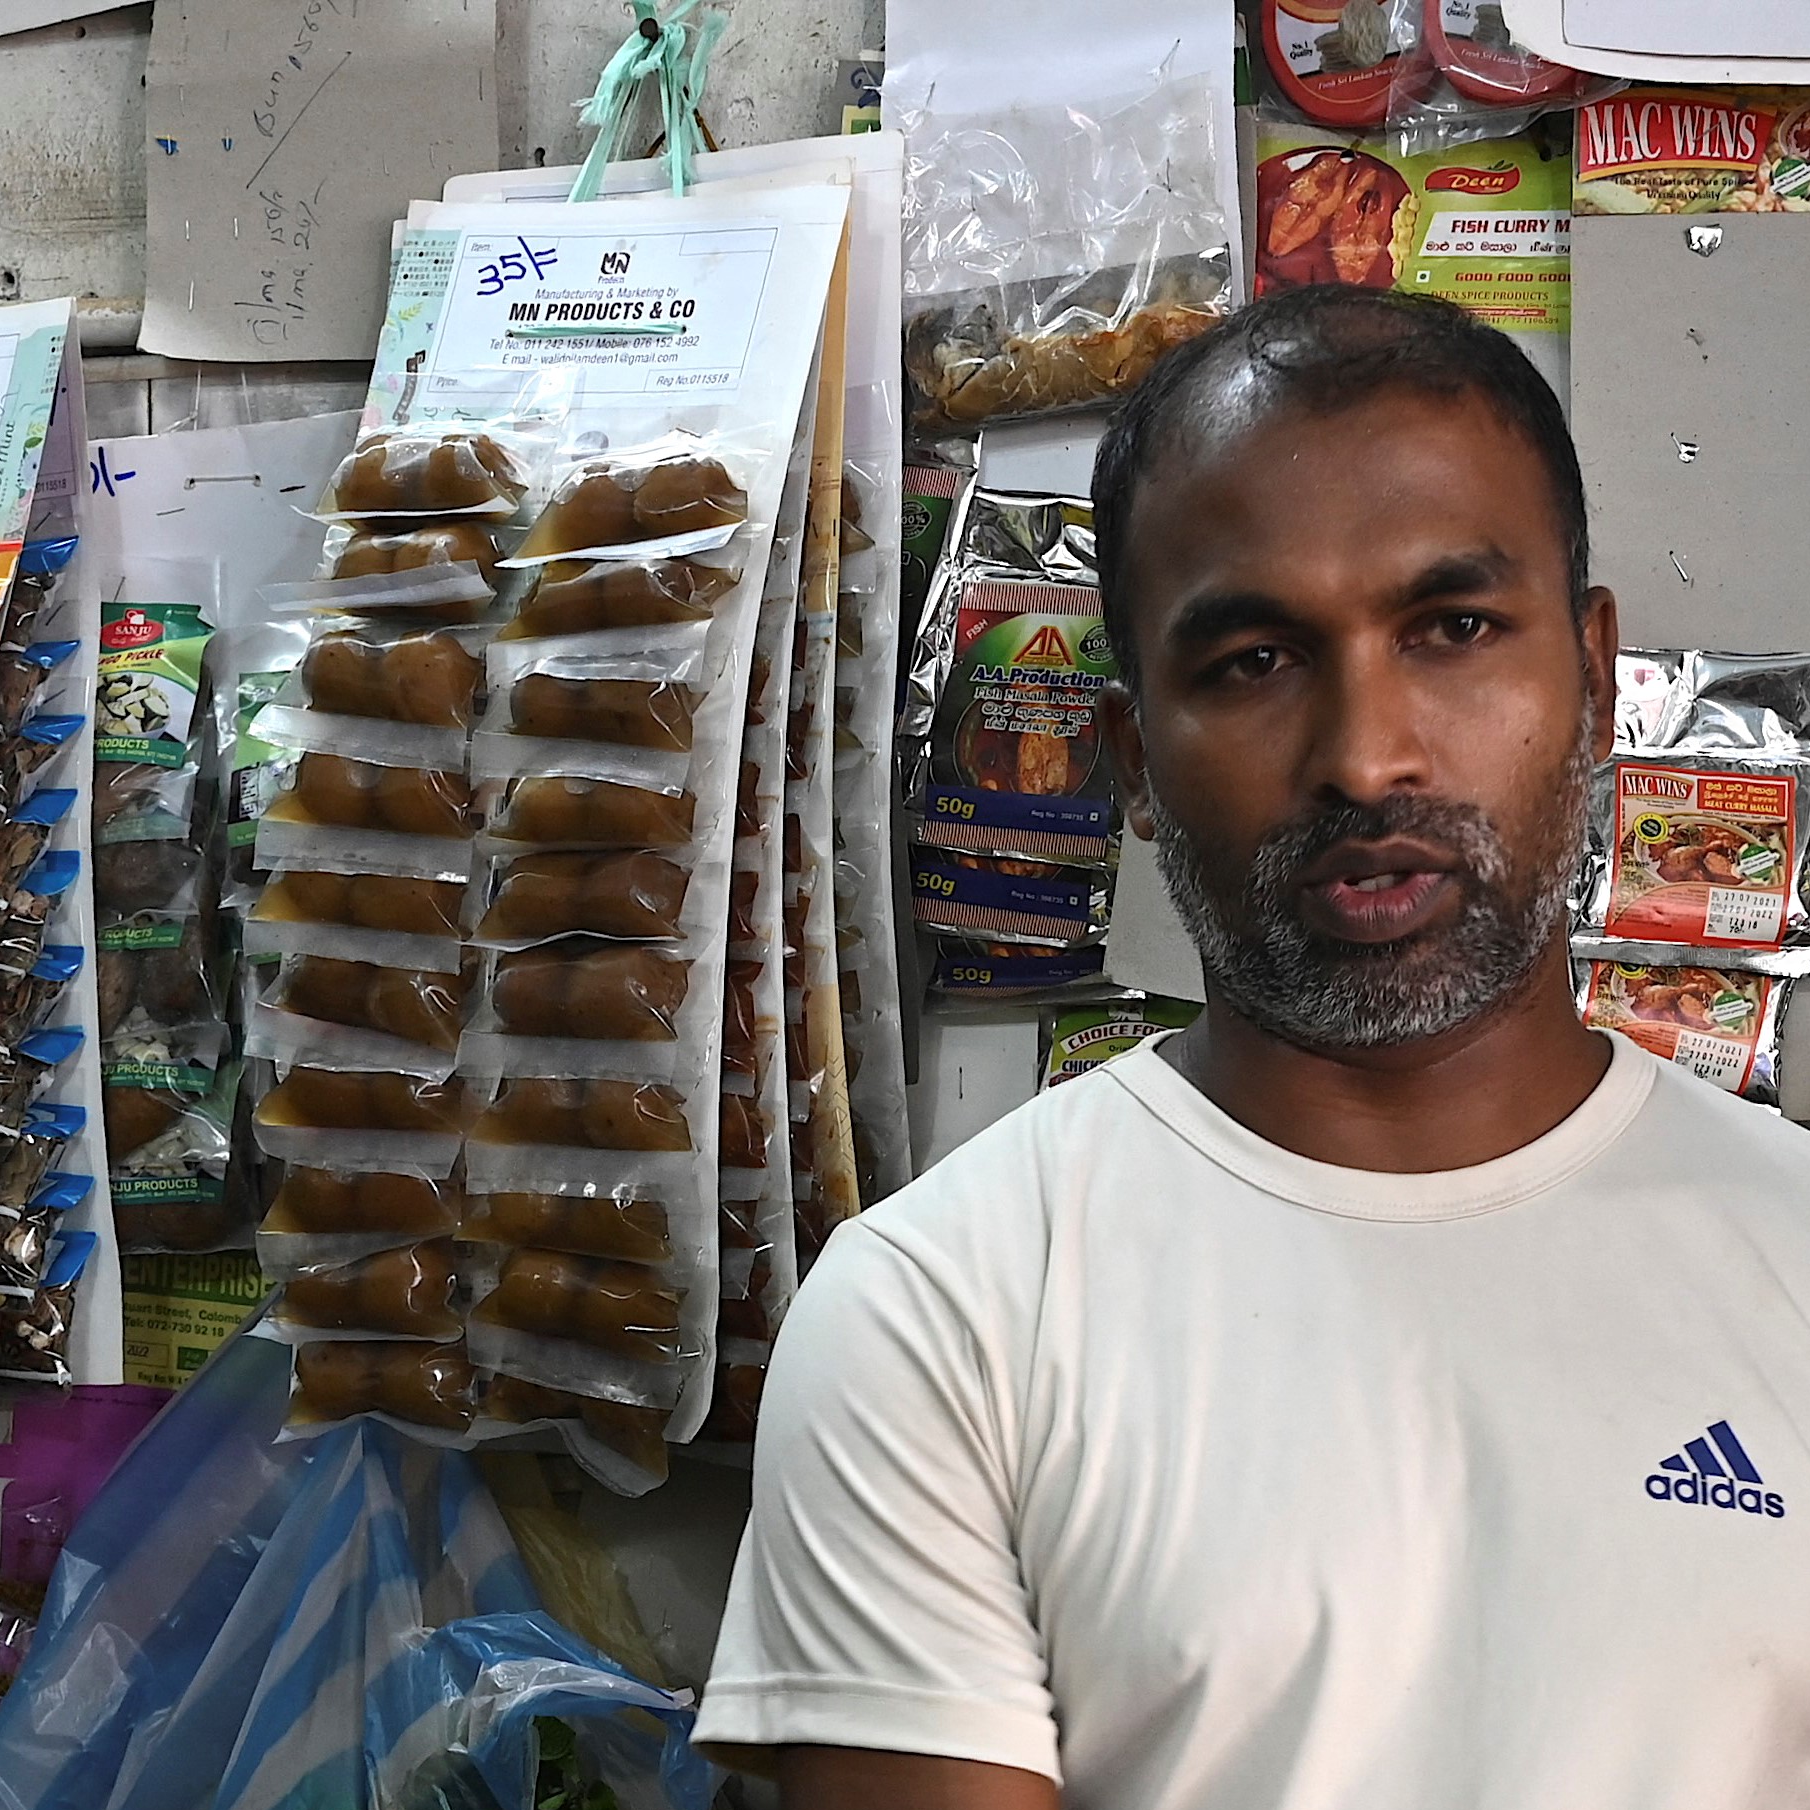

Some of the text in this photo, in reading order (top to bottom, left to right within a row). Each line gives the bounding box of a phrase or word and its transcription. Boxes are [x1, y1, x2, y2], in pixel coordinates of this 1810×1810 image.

[1290, 48, 1313, 59] Quality
[1586, 103, 1757, 166] MAC WINS
[1448, 173, 1504, 190] Deen
[1451, 219, 1548, 233] FISH CURRY
[601, 252, 630, 275] MN
[1455, 272, 1533, 282] GOOD FOOD
[535, 287, 678, 300] Manufacturing Marketing by
[1460, 291, 1549, 301] SPICE PRODUCTS
[509, 300, 695, 321] MN PRODUCTS & CO
[524, 338, 540, 350] 011
[543, 338, 564, 350] 242
[633, 336, 652, 348] 076
[655, 336, 672, 348] 152
[511, 352, 531, 364] mail
[115, 626, 152, 636] SANJU
[966, 619, 988, 640] FISH
[124, 649, 165, 661] PICKLE
[975, 687, 1049, 703] Fish Masala
[1625, 776, 1687, 799] MAC WINS
[936, 797, 975, 820] 50g
[916, 872, 955, 896] 50g
[952, 968, 992, 983] 50g
[1068, 1025, 1128, 1051] CHOICE
[117, 1063, 179, 1077] PRODUCTS
[134, 1177, 198, 1191] PRODUCTS
[195, 1324, 208, 1335] 92
[212, 1326, 224, 1337] 18
[1645, 1472, 1785, 1518] adidas
